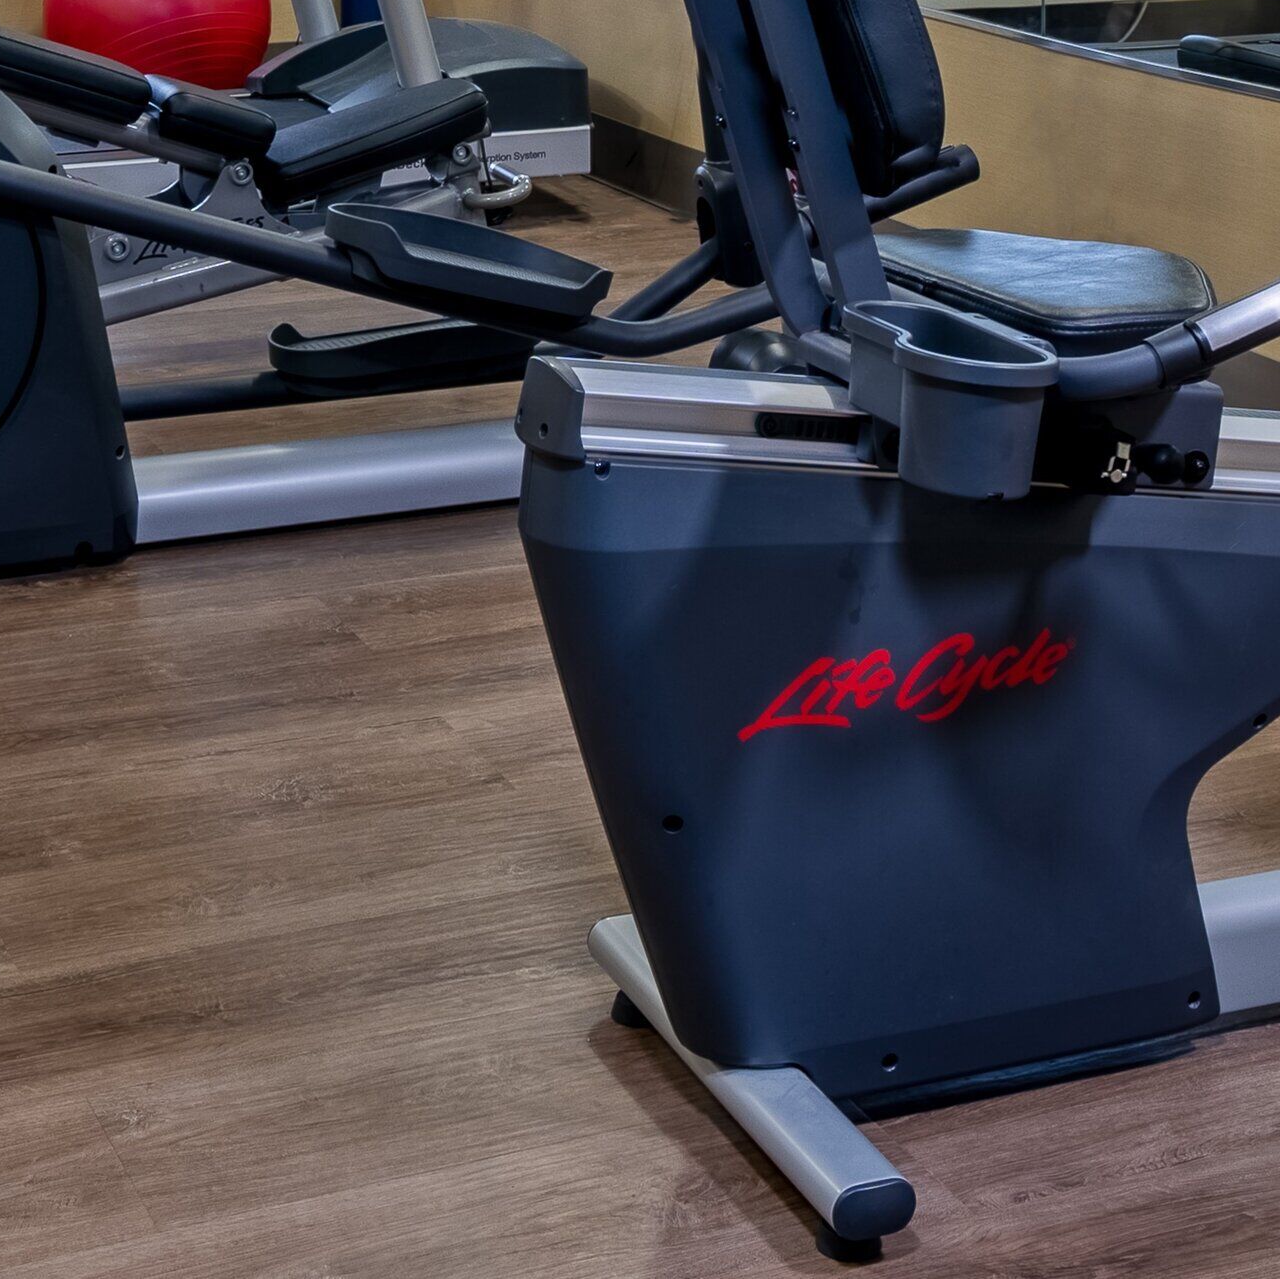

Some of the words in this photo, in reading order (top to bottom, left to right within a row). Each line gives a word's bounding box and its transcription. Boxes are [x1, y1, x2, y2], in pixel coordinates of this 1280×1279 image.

[513, 150, 547, 164] System
[736, 647, 897, 743] Life
[894, 627, 1070, 723] Cycle
